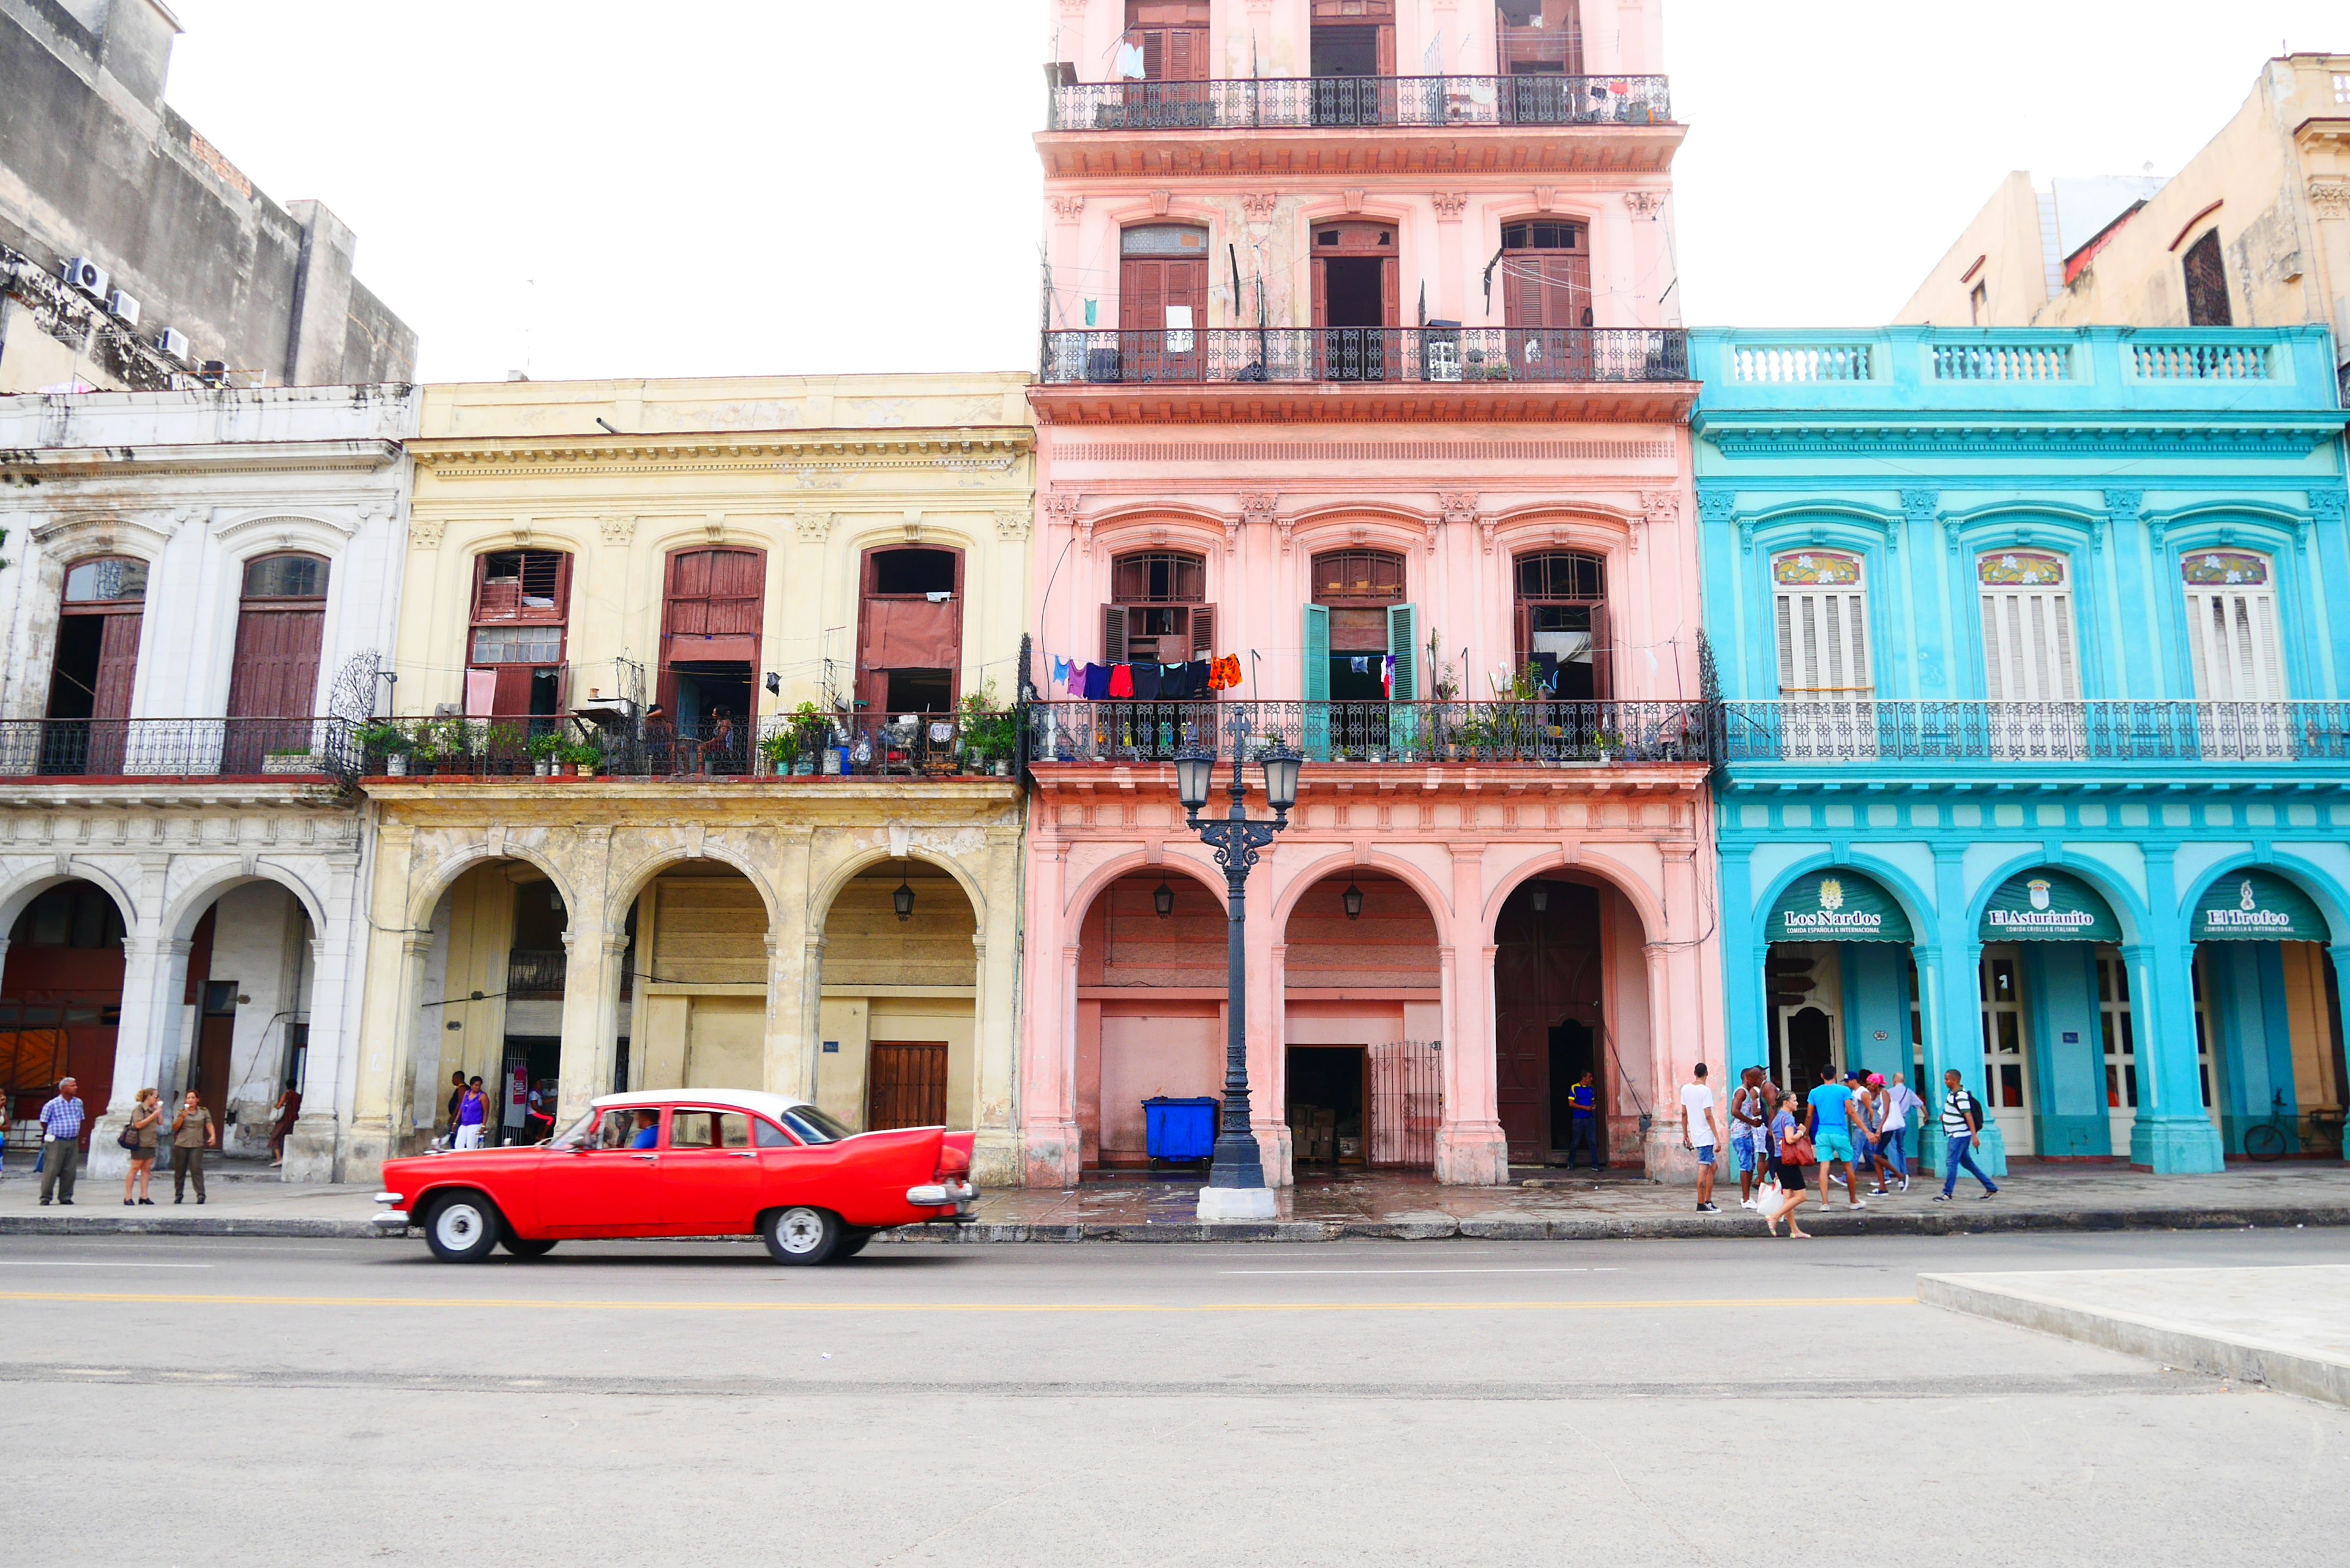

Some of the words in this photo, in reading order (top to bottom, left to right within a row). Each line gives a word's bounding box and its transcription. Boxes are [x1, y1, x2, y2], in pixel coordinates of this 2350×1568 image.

[1785, 911, 1815, 925] Los
[1817, 911, 1881, 925] Nardos
[1989, 911, 2007, 925] El
[2009, 909, 2094, 925] Asturianito
[2207, 909, 2228, 925] El
[2229, 909, 2289, 925] Trofeo
